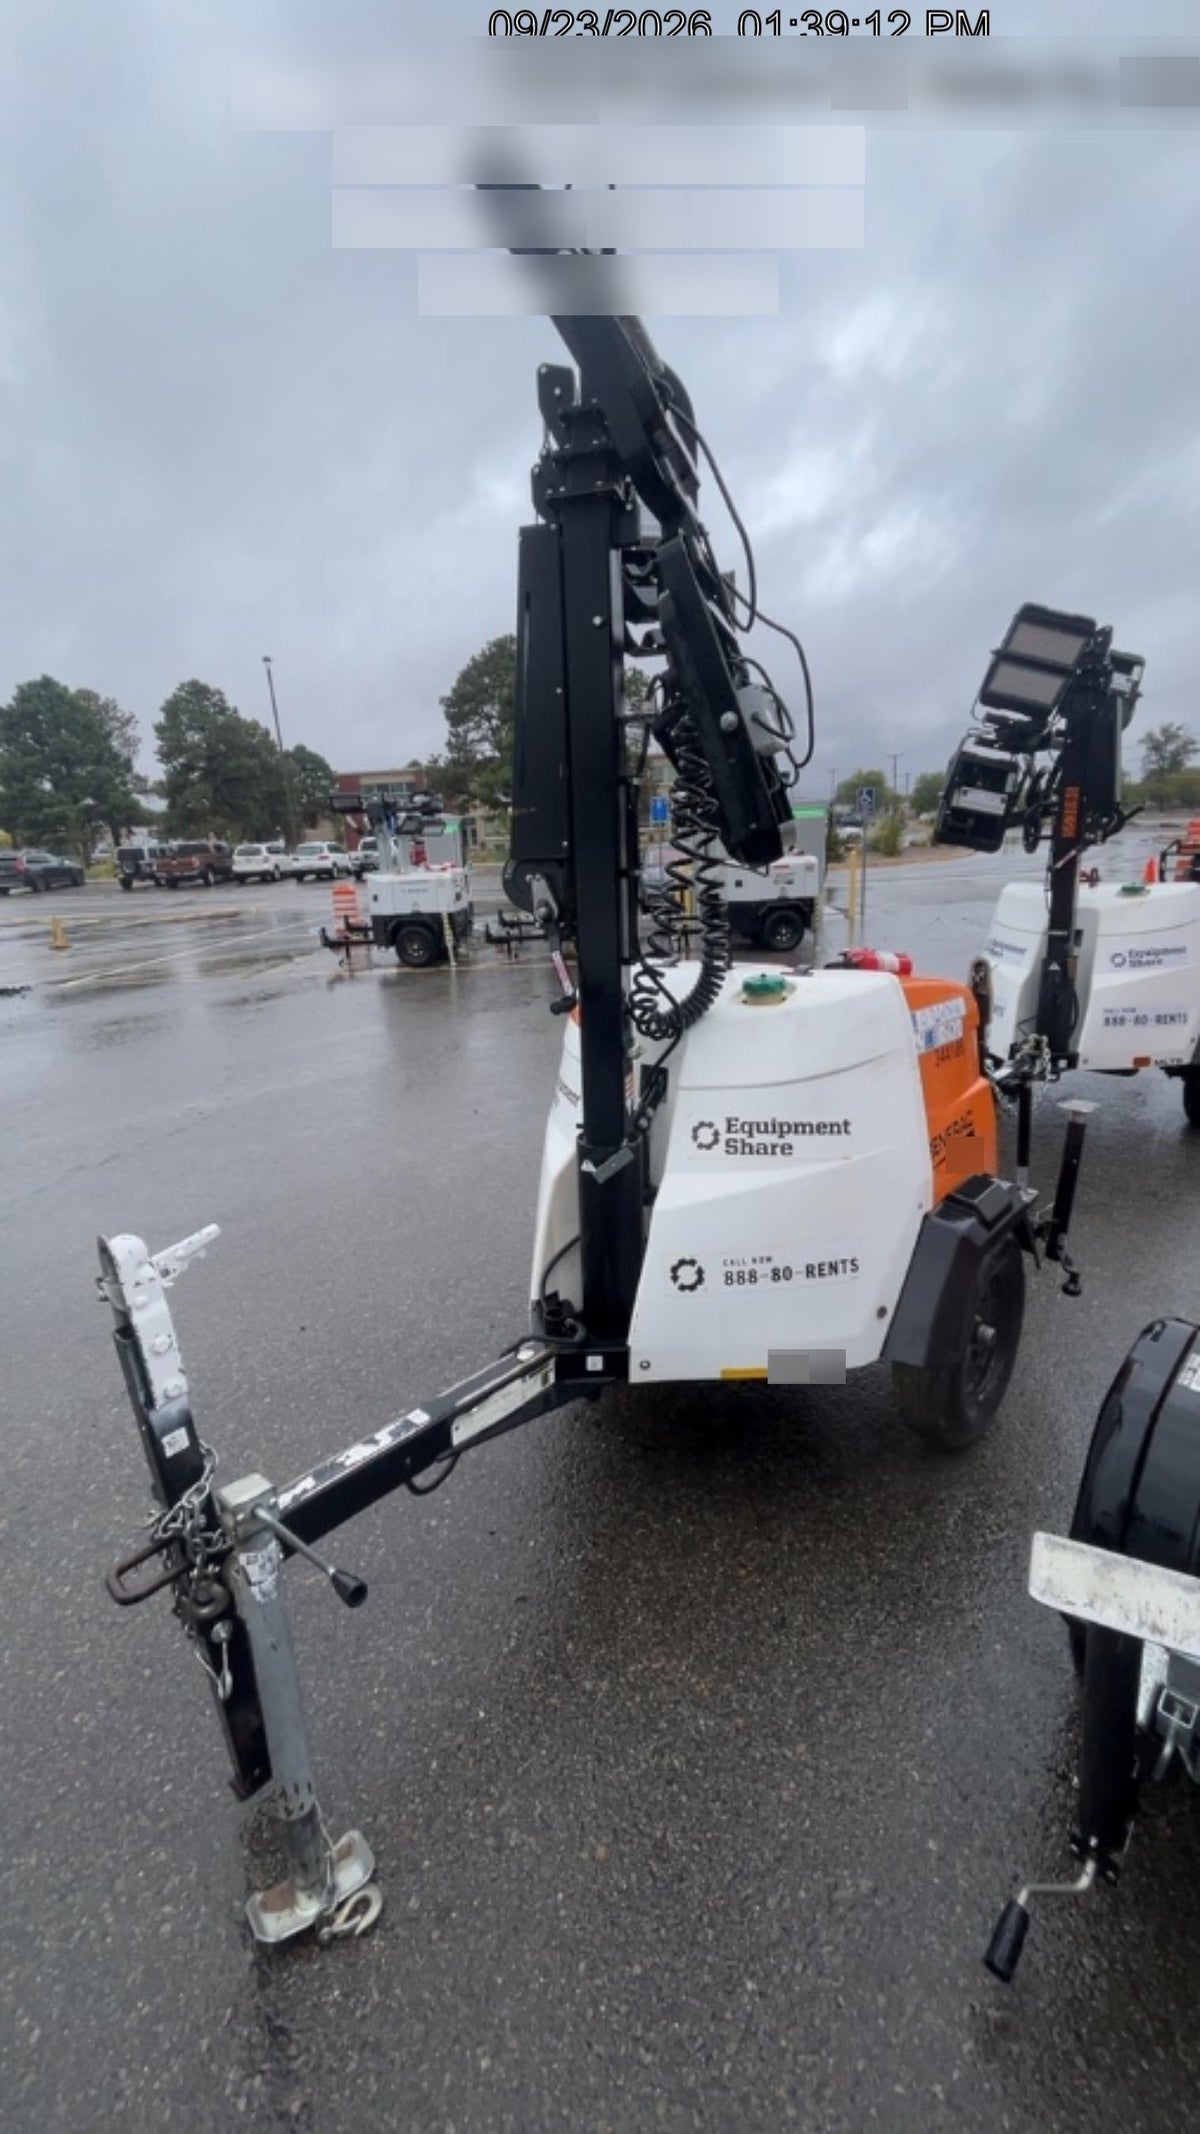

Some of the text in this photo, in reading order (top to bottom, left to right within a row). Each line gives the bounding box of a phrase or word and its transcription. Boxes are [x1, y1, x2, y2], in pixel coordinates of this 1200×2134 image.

[725, 1116, 852, 1138] Equipment
[725, 1138, 793, 1156] Share
[723, 1256, 773, 1267] CALL NOW
[724, 1257, 860, 1286] 888-80-RENTS
